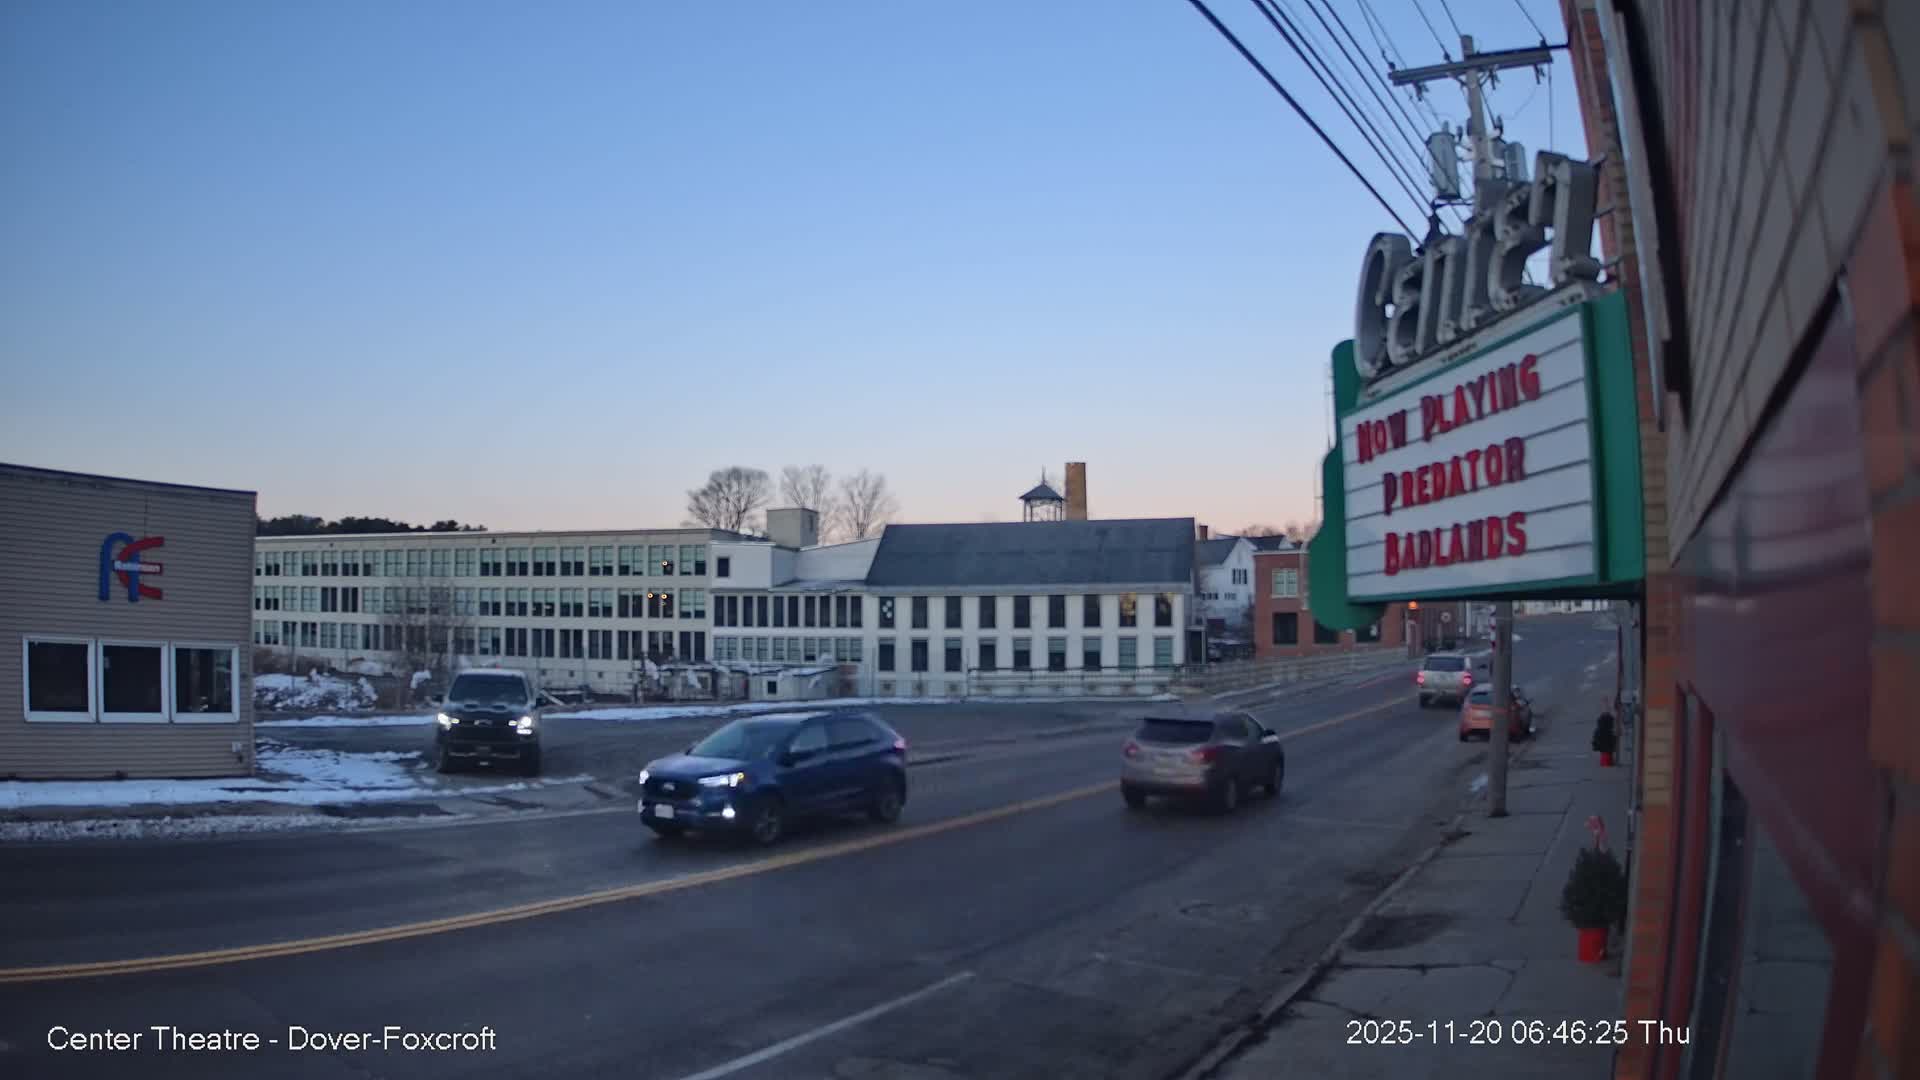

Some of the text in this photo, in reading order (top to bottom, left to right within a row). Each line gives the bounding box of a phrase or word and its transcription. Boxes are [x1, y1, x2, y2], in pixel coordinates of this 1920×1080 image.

[1356, 353, 1541, 464] NOW PLAYING
[1383, 436, 1527, 516] PREDATOR
[1384, 511, 1527, 576] BADLANDS
